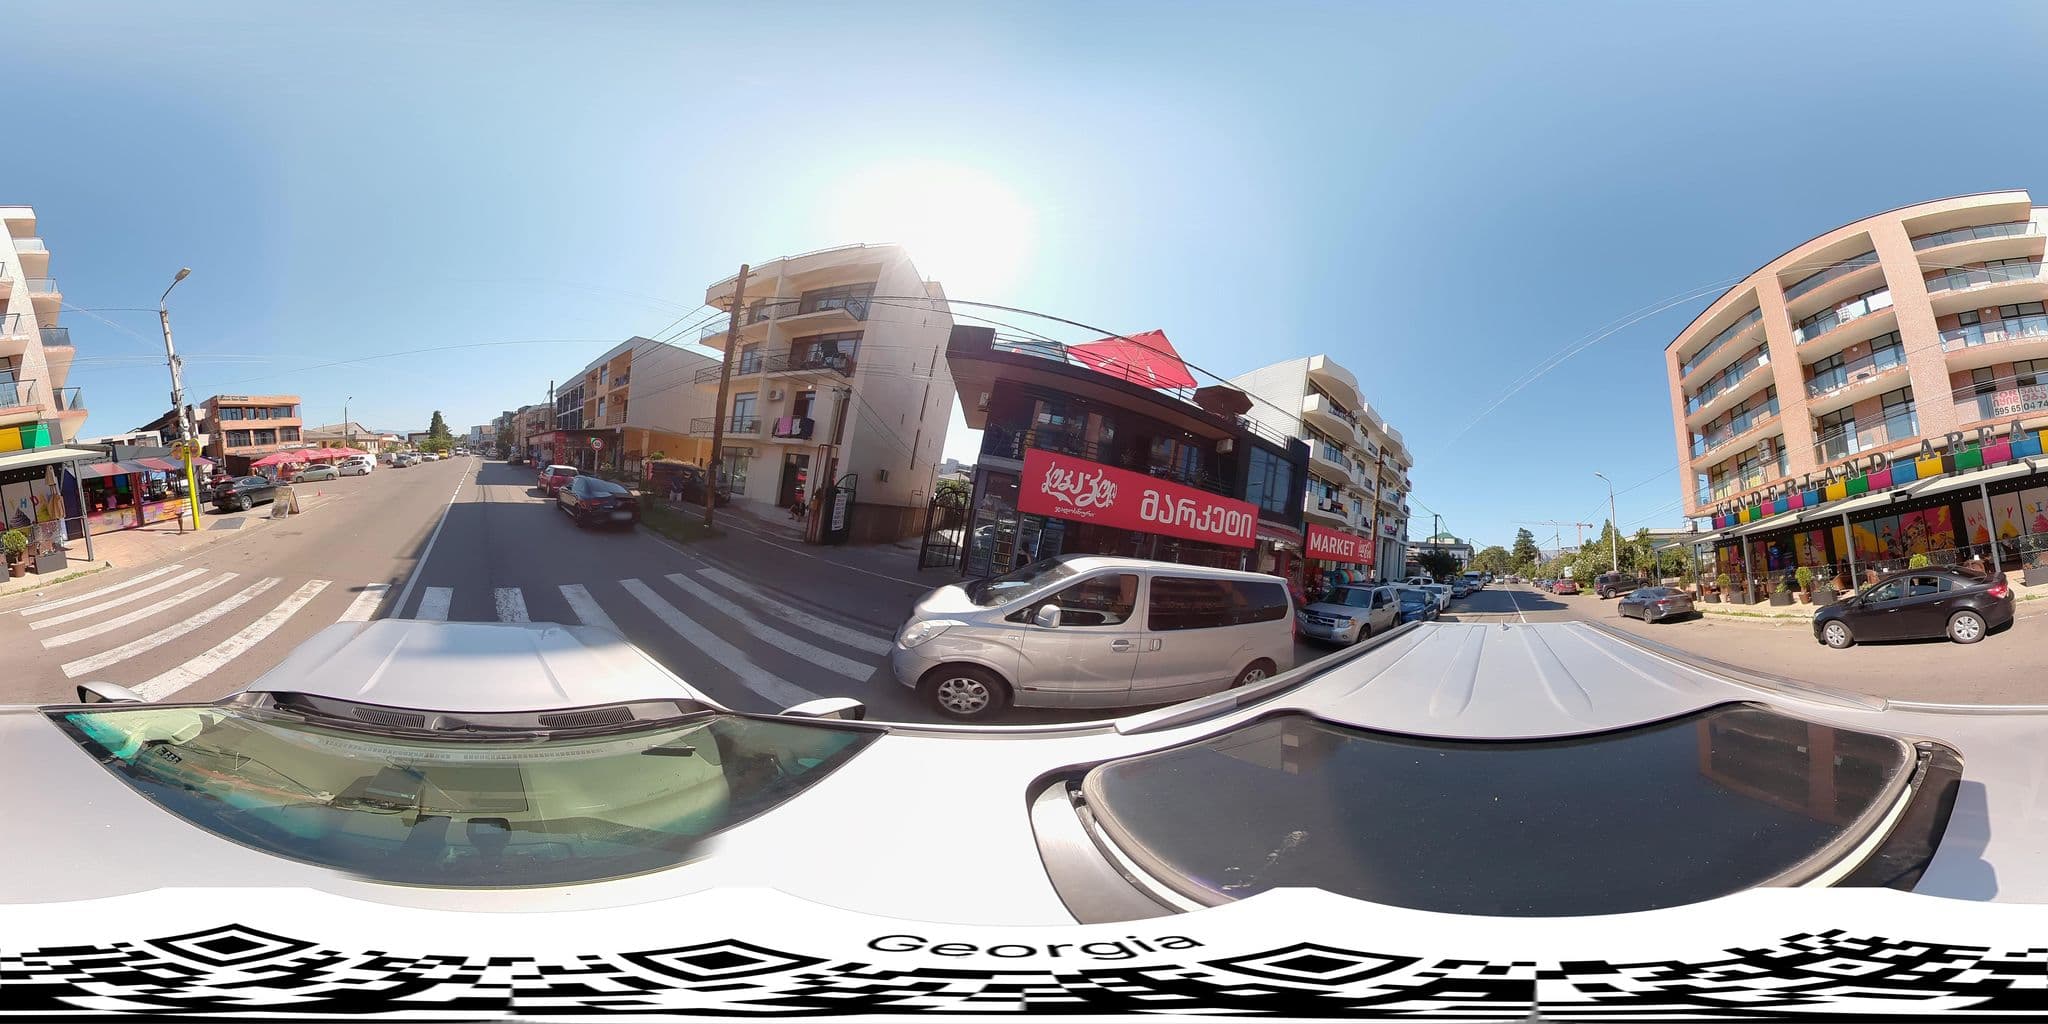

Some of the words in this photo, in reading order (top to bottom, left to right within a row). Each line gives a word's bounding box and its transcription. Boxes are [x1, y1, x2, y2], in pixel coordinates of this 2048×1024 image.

[1993, 390, 2016, 401] FOR
[1995, 406, 2009, 416] 595
[2011, 405, 2021, 413] 65
[2024, 402, 2036, 410] 04
[1716, 452, 1888, 517] KINDERLAND
[1919, 420, 2030, 460] AREA
[1141, 490, 1253, 538] მარკეტი
[1310, 533, 1355, 557] MARKET
